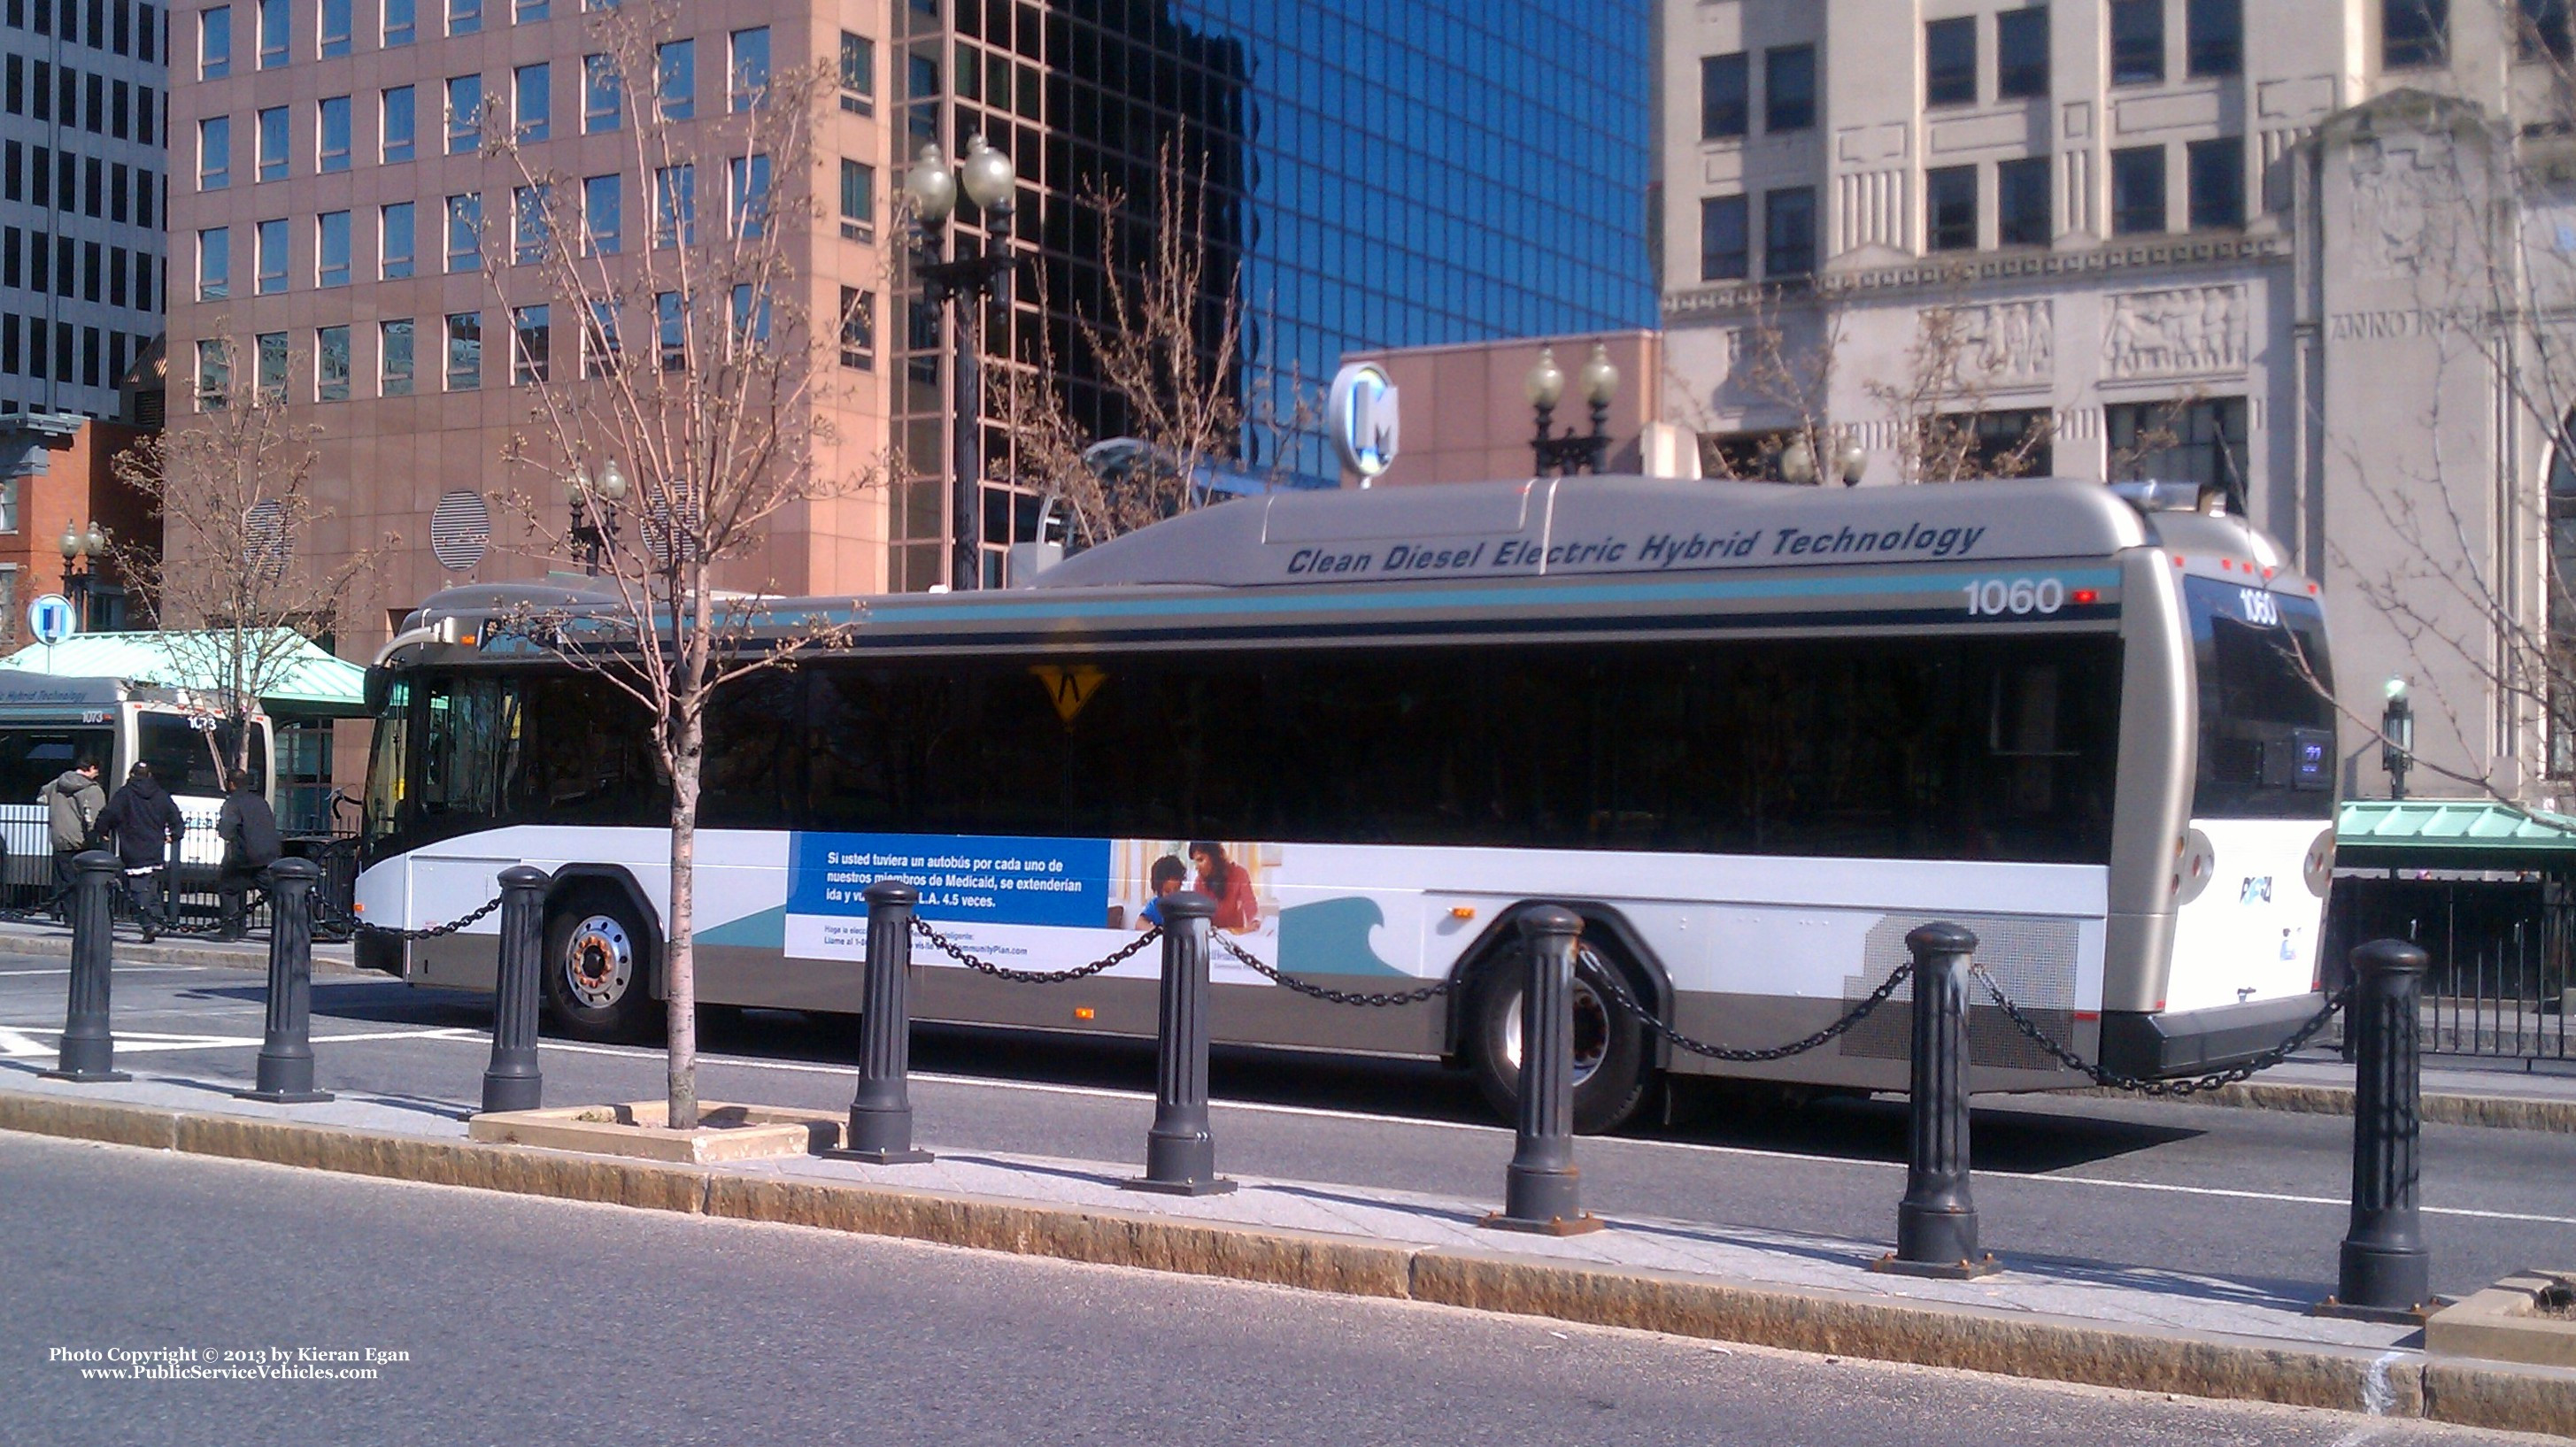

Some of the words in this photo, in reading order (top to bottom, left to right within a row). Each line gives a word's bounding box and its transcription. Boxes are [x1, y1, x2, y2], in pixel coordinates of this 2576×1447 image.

[1287, 548, 1371, 574] Clean
[1382, 542, 1485, 571] Diesel
[1492, 535, 1627, 566] Electric
[1638, 531, 1762, 567] Hybrid
[1770, 522, 1986, 556] Technology
[1962, 576, 2066, 616] 1060
[2240, 588, 2278, 626] 1060
[81, 710, 104, 724] 1073
[827, 851, 840, 864] Si
[841, 852, 870, 866] usted
[873, 853, 908, 866] tuviera
[911, 857, 925, 867] un
[927, 855, 971, 869] autobús
[973, 859, 991, 871] por
[995, 857, 1022, 871] cada
[1024, 861, 1046, 872] uno
[1048, 858, 1063, 872] de
[827, 872, 872, 884] nuestros
[929, 874, 943, 887] de
[945, 874, 999, 890] Medicaid,
[1000, 878, 1014, 889] se
[1016, 877, 1083, 892] extenderían
[826, 888, 843, 901] ida
[844, 890, 851, 904] y
[918, 892, 940, 904] L.A.
[942, 893, 959, 905] 4.5
[961, 896, 997, 908] veces.
